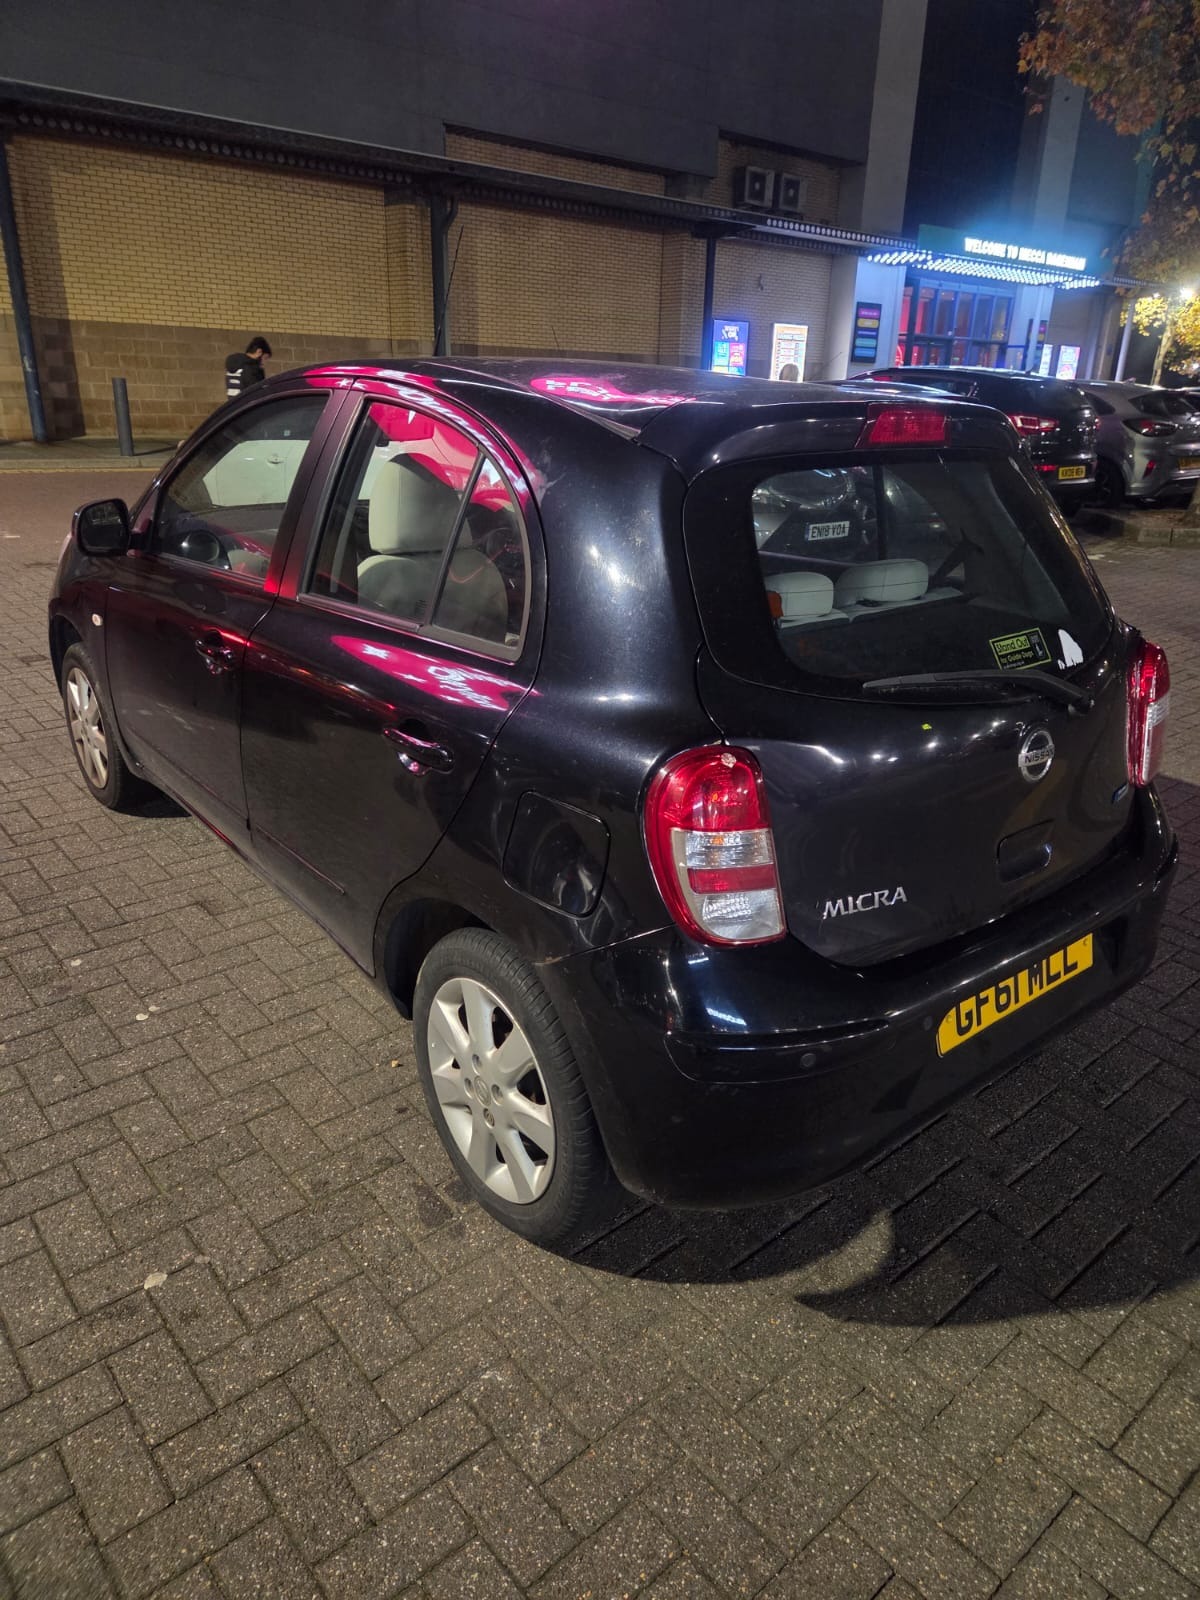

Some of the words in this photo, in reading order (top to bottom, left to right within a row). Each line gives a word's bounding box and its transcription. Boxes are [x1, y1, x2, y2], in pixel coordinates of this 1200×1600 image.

[964, 237, 1007, 258] WELCOME
[1007, 244, 1019, 260] TO
[1018, 247, 1046, 264] MECCA
[822, 886, 908, 920] MICRA
[955, 975, 1020, 1036] GF61
[1027, 949, 1078, 997] MLL
